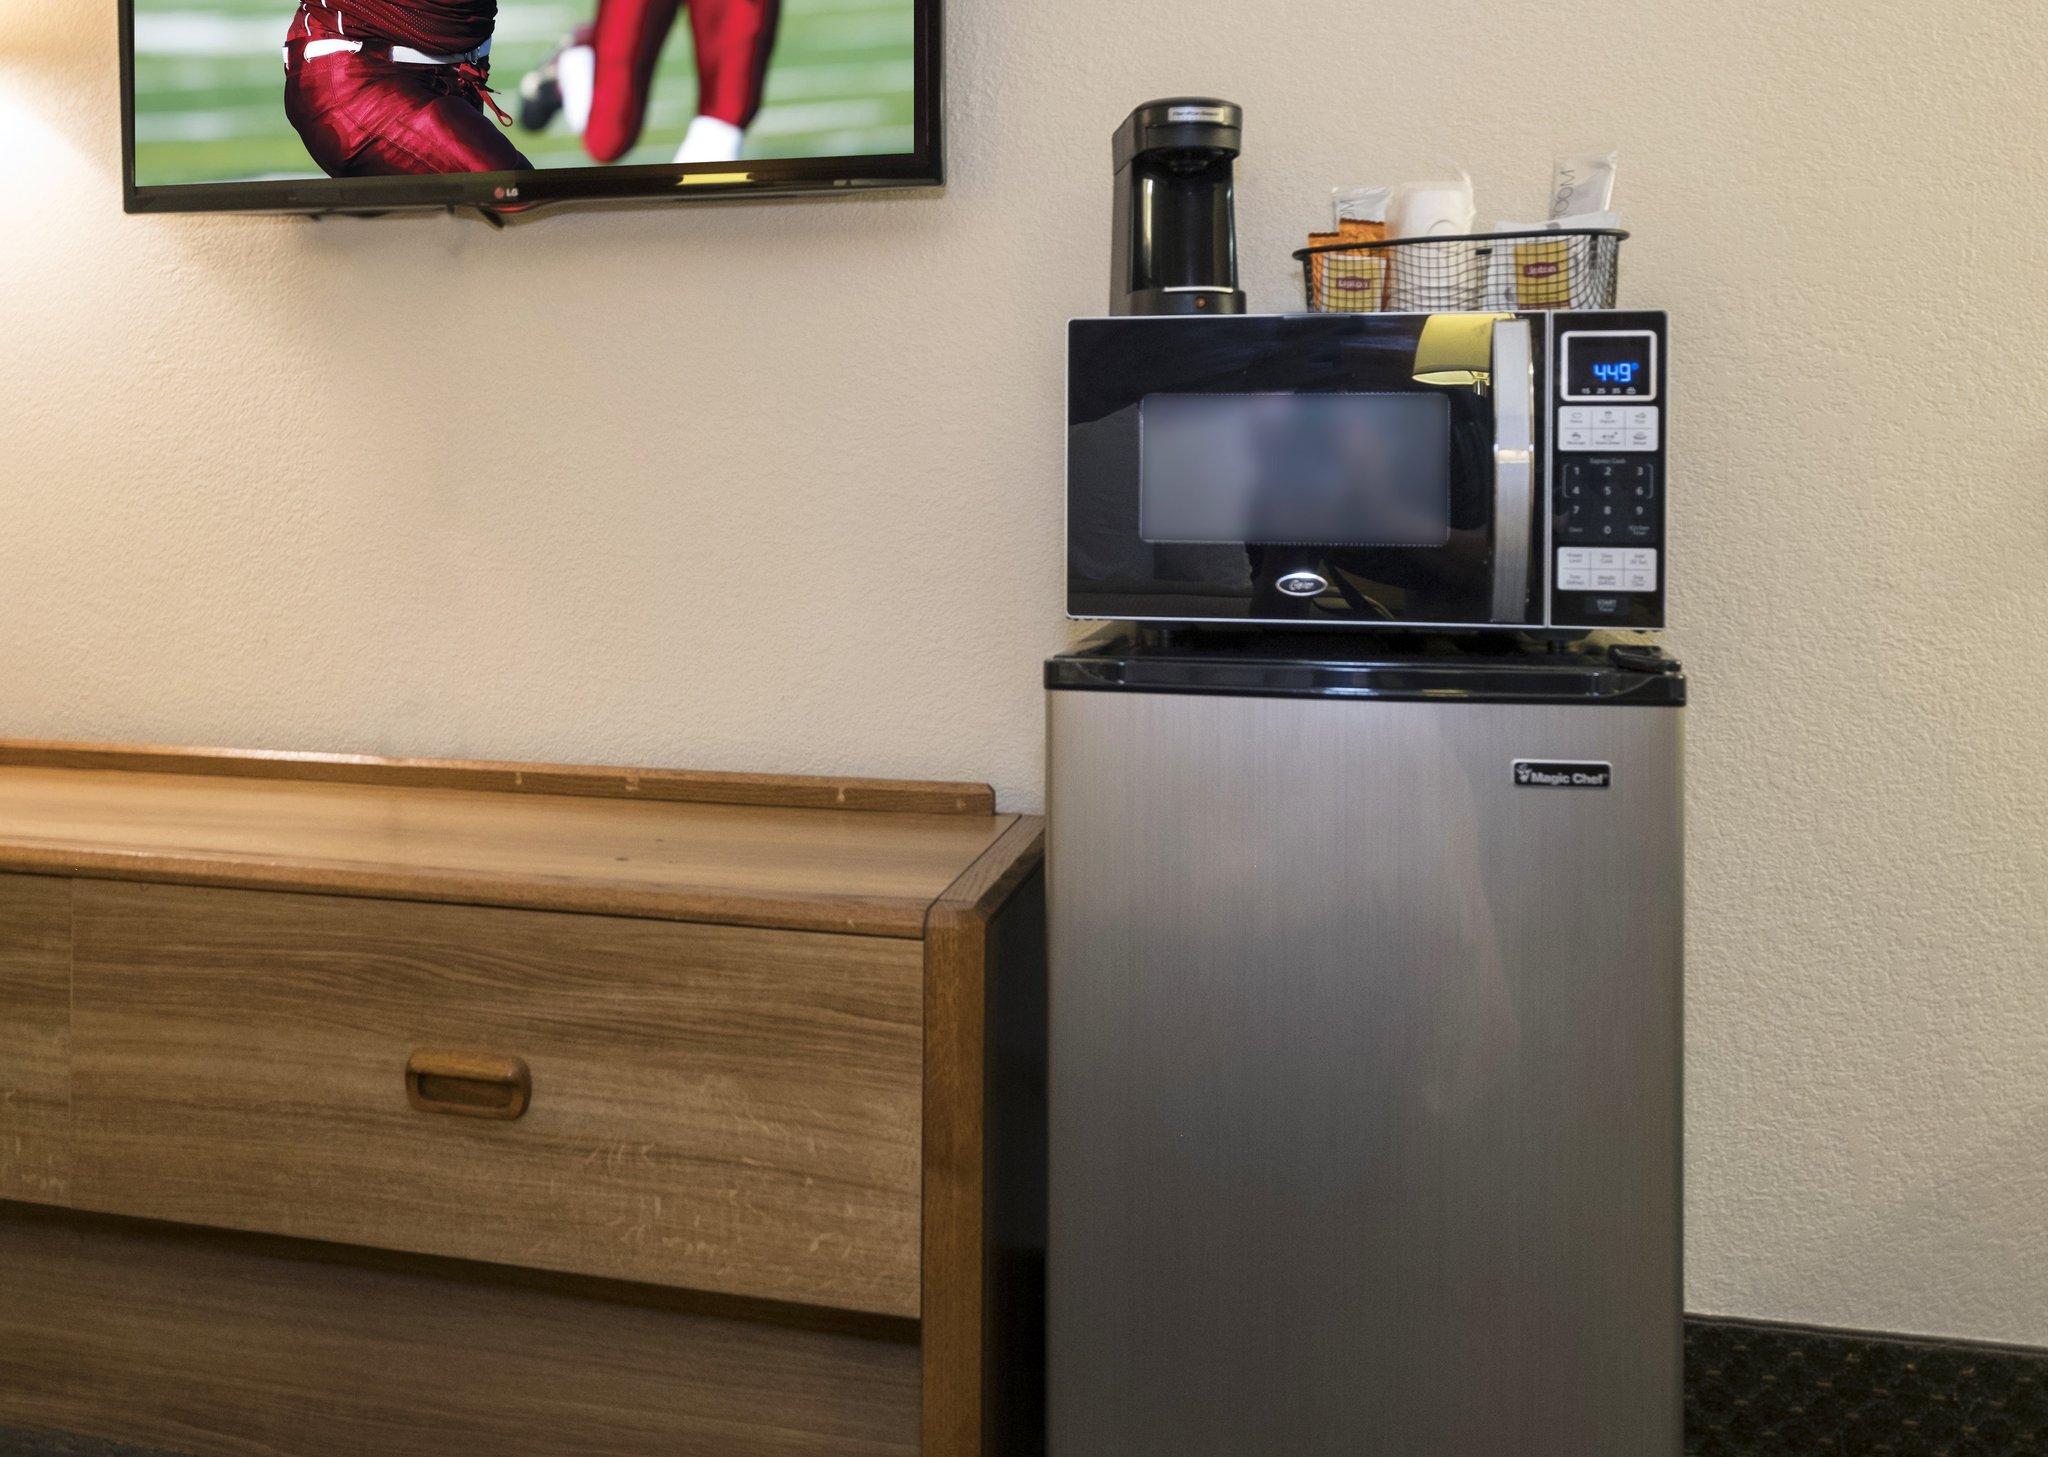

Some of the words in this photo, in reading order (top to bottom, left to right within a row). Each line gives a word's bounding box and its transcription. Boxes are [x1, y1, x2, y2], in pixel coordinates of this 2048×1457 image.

[506, 188, 519, 197] LG
[1553, 169, 1575, 220] OOM
[1604, 466, 1612, 476] 2
[1636, 466, 1644, 476] 3
[1572, 486, 1580, 495] 4
[1604, 486, 1612, 496] 5
[1636, 486, 1644, 496] 6
[1572, 505, 1580, 514] 7
[1603, 505, 1612, 515] 8
[1636, 505, 1644, 515] 9
[1603, 525, 1612, 535] 0
[1531, 772, 1570, 785] Magic
[1572, 773, 1604, 784] Chef
